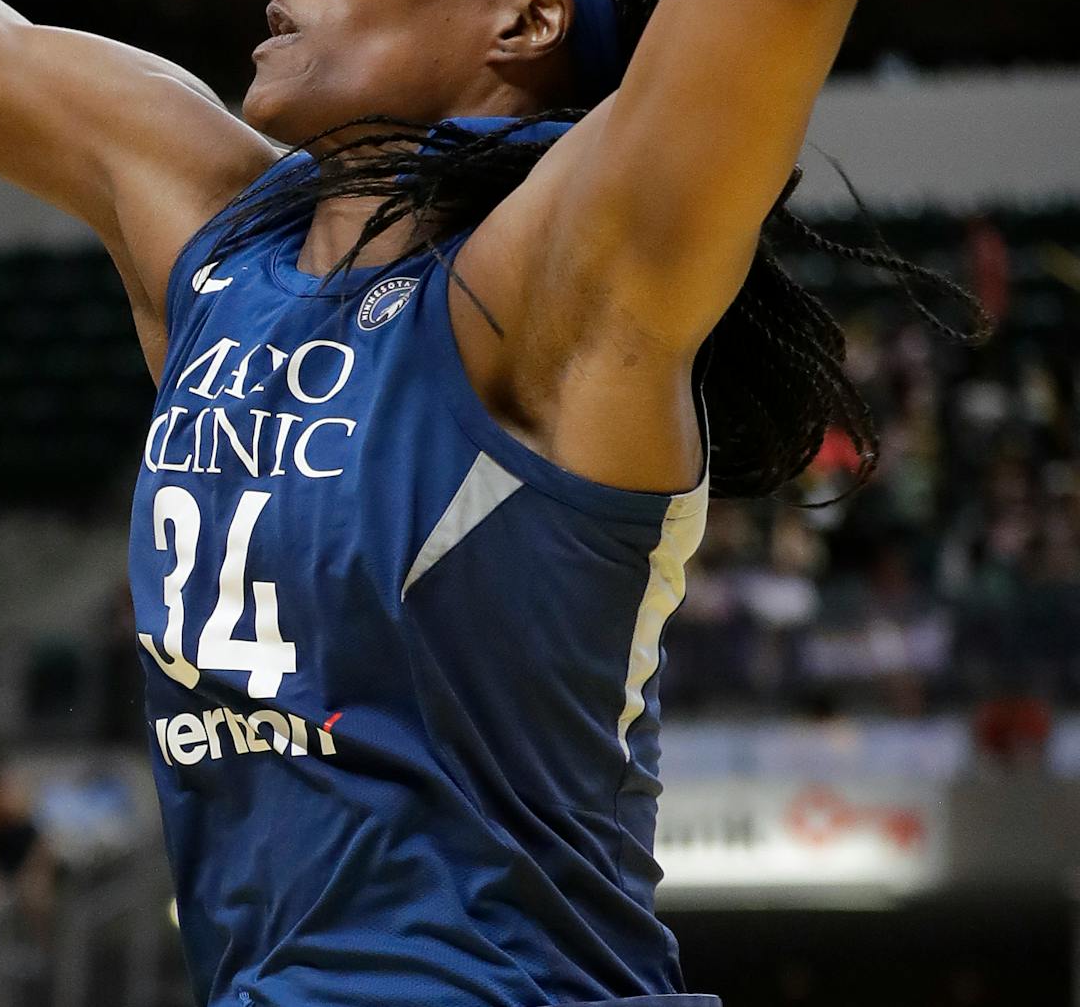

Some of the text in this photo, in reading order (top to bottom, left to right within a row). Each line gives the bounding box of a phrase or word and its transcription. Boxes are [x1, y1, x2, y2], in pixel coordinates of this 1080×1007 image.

[360, 280, 411, 321] MINNESOTA
[145, 406, 357, 478] CLINIC
[138, 486, 297, 699] 34
